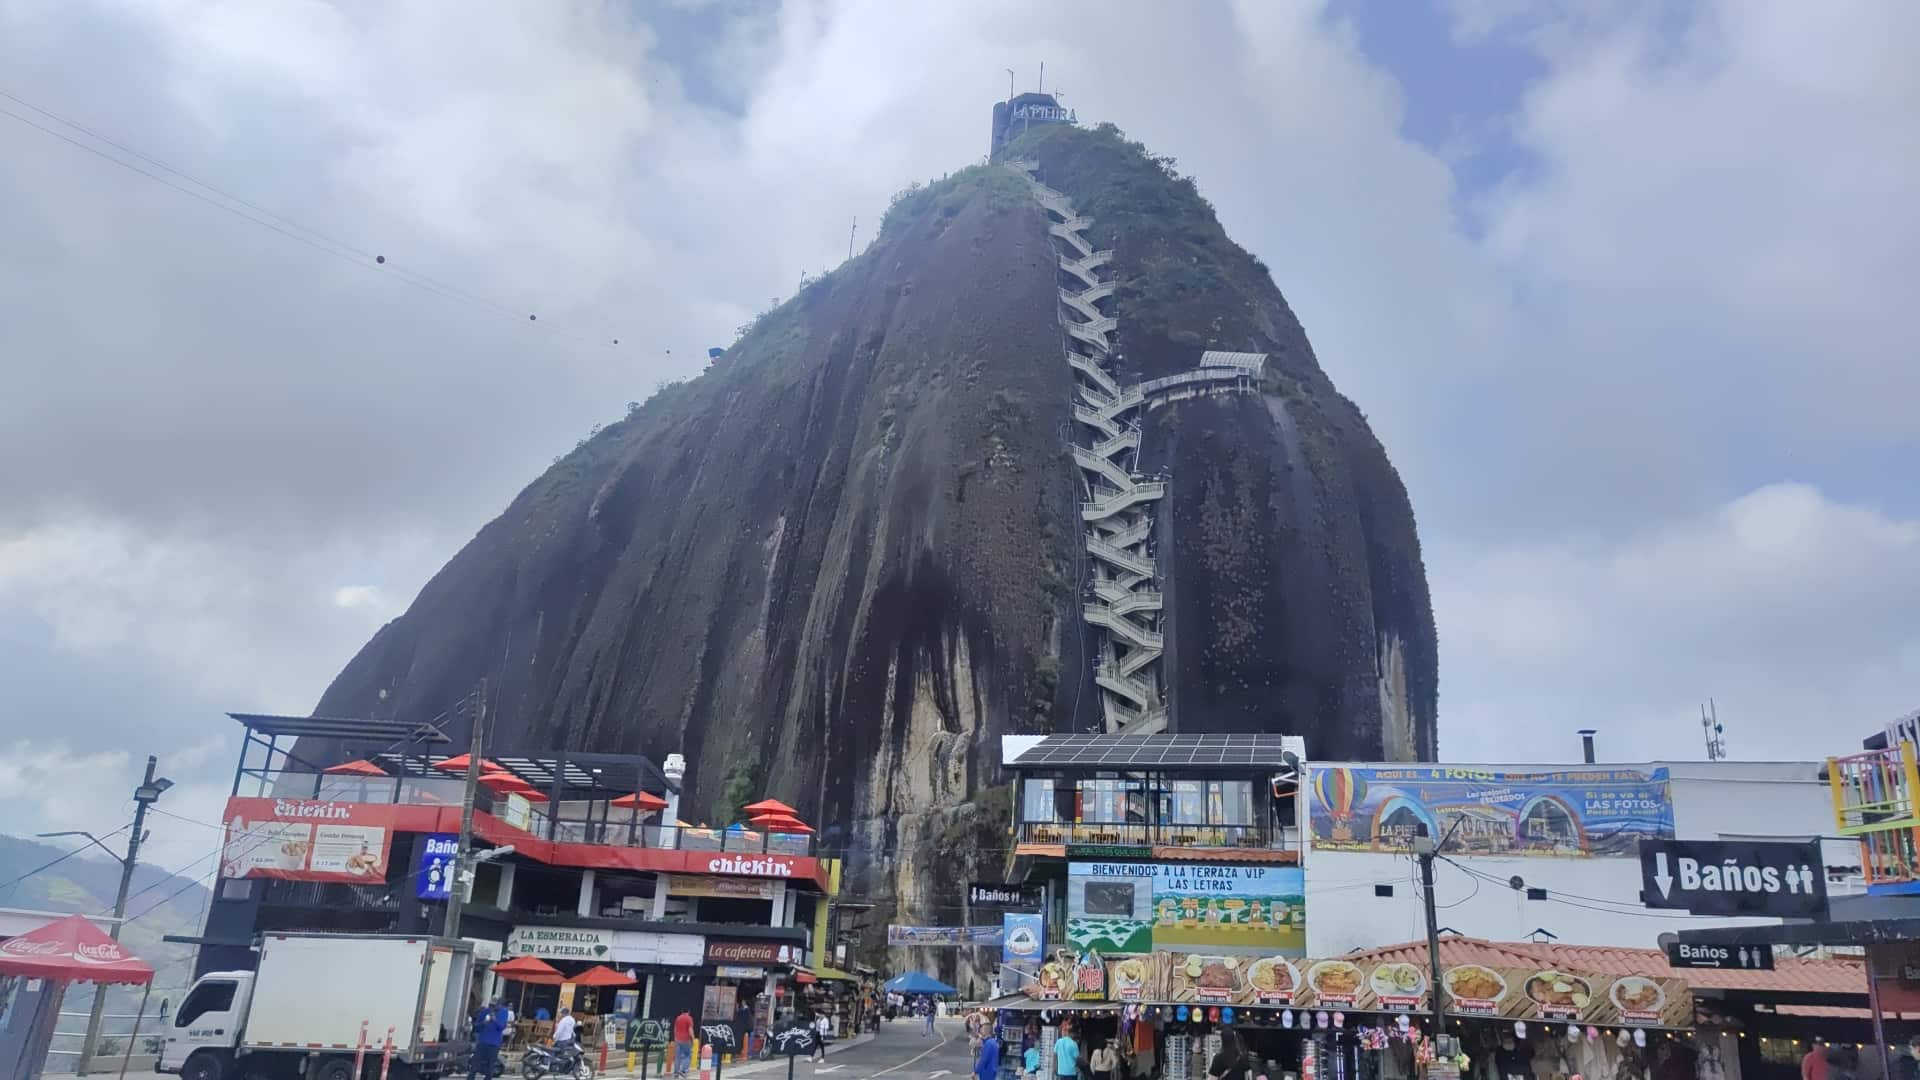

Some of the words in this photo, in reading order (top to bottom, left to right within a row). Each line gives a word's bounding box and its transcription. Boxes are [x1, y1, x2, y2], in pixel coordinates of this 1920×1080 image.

[1013, 103, 1029, 119] LA
[1445, 768, 1496, 780] FOTOS
[1585, 799, 1610, 809] LAS
[1615, 799, 1656, 810] FOTOS
[426, 838, 458, 854] Baño
[1092, 864, 1158, 876] BIENVENIDOS
[1164, 867, 1170, 877] A
[1174, 867, 1186, 878] LA
[1191, 867, 1238, 879] TERRAZA
[1245, 869, 1265, 880] VIP
[1678, 857, 1780, 894] Baños
[1168, 879, 1189, 891] LAS
[1194, 880, 1233, 892] LETRAS
[979, 888, 1010, 902] Baños
[520, 930, 534, 940] LA
[537, 931, 600, 943] ESMERALDA
[520, 943, 535, 953] EN
[537, 944, 550, 954] LA
[553, 945, 592, 956] PIEDRA
[709, 944, 722, 958] La
[724, 945, 772, 961] cafetería
[1679, 944, 1729, 960] Baños
